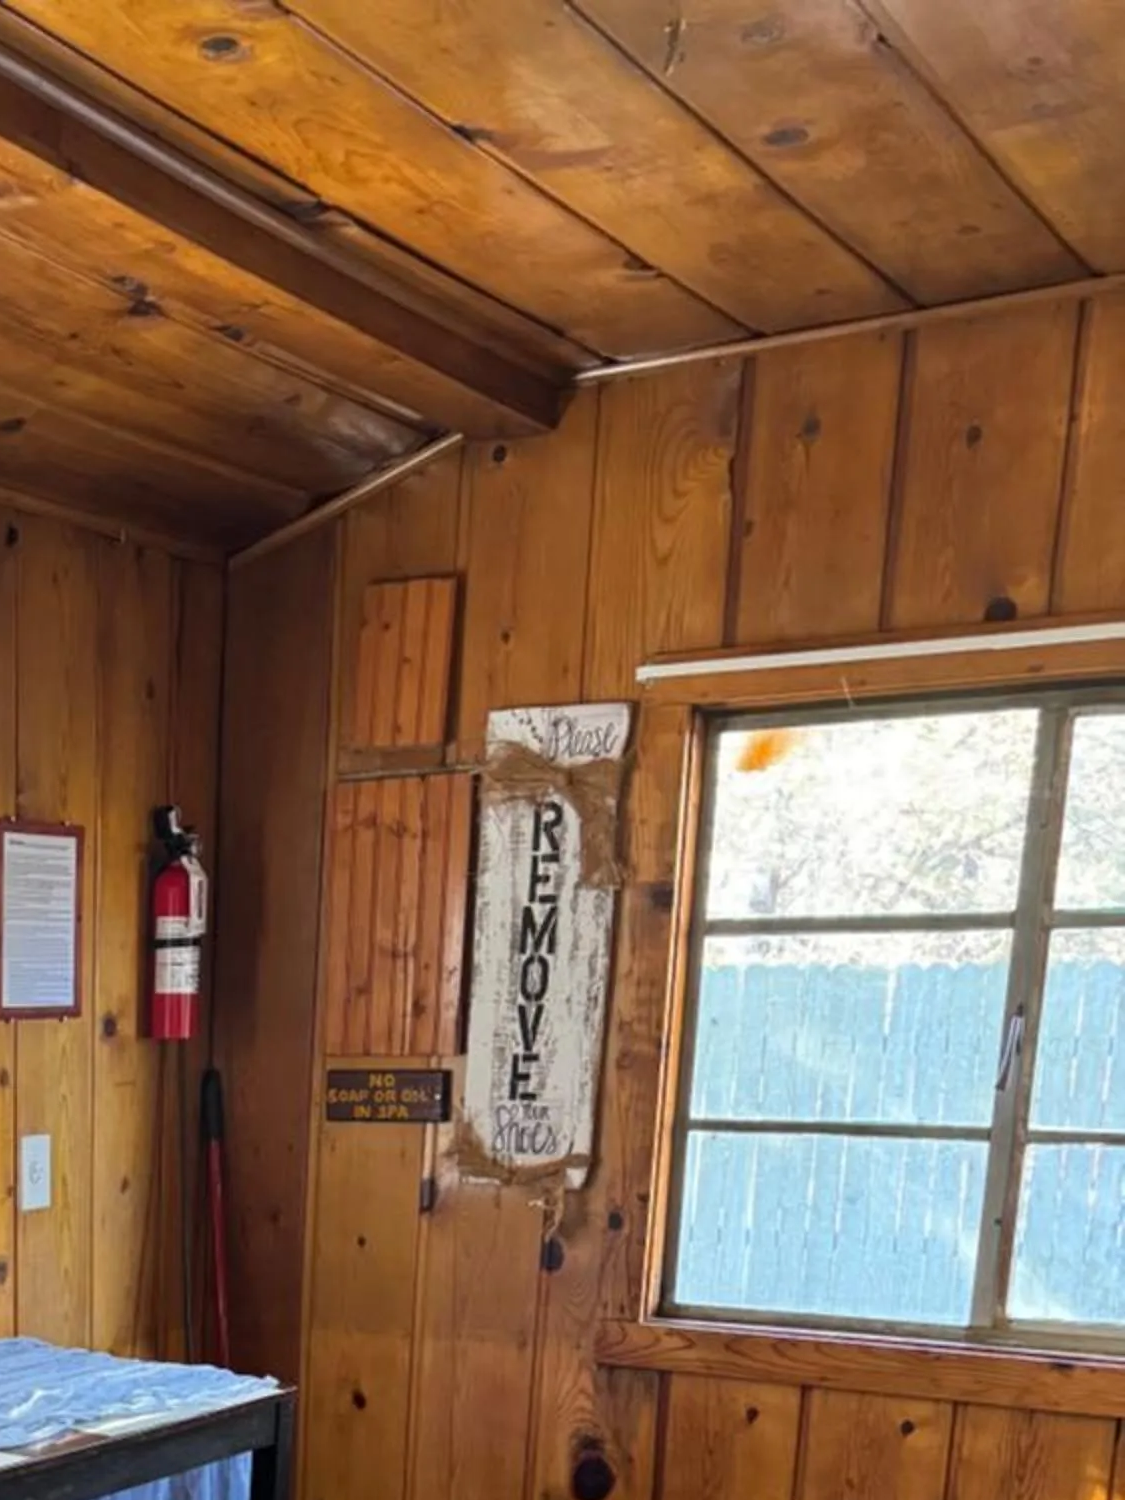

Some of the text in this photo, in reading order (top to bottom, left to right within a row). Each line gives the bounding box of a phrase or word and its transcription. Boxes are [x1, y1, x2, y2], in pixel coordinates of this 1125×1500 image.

[548, 715, 617, 761] Please
[508, 800, 564, 1101] REMOVE
[369, 1073, 396, 1088] NO
[352, 1104, 373, 1118] IN
